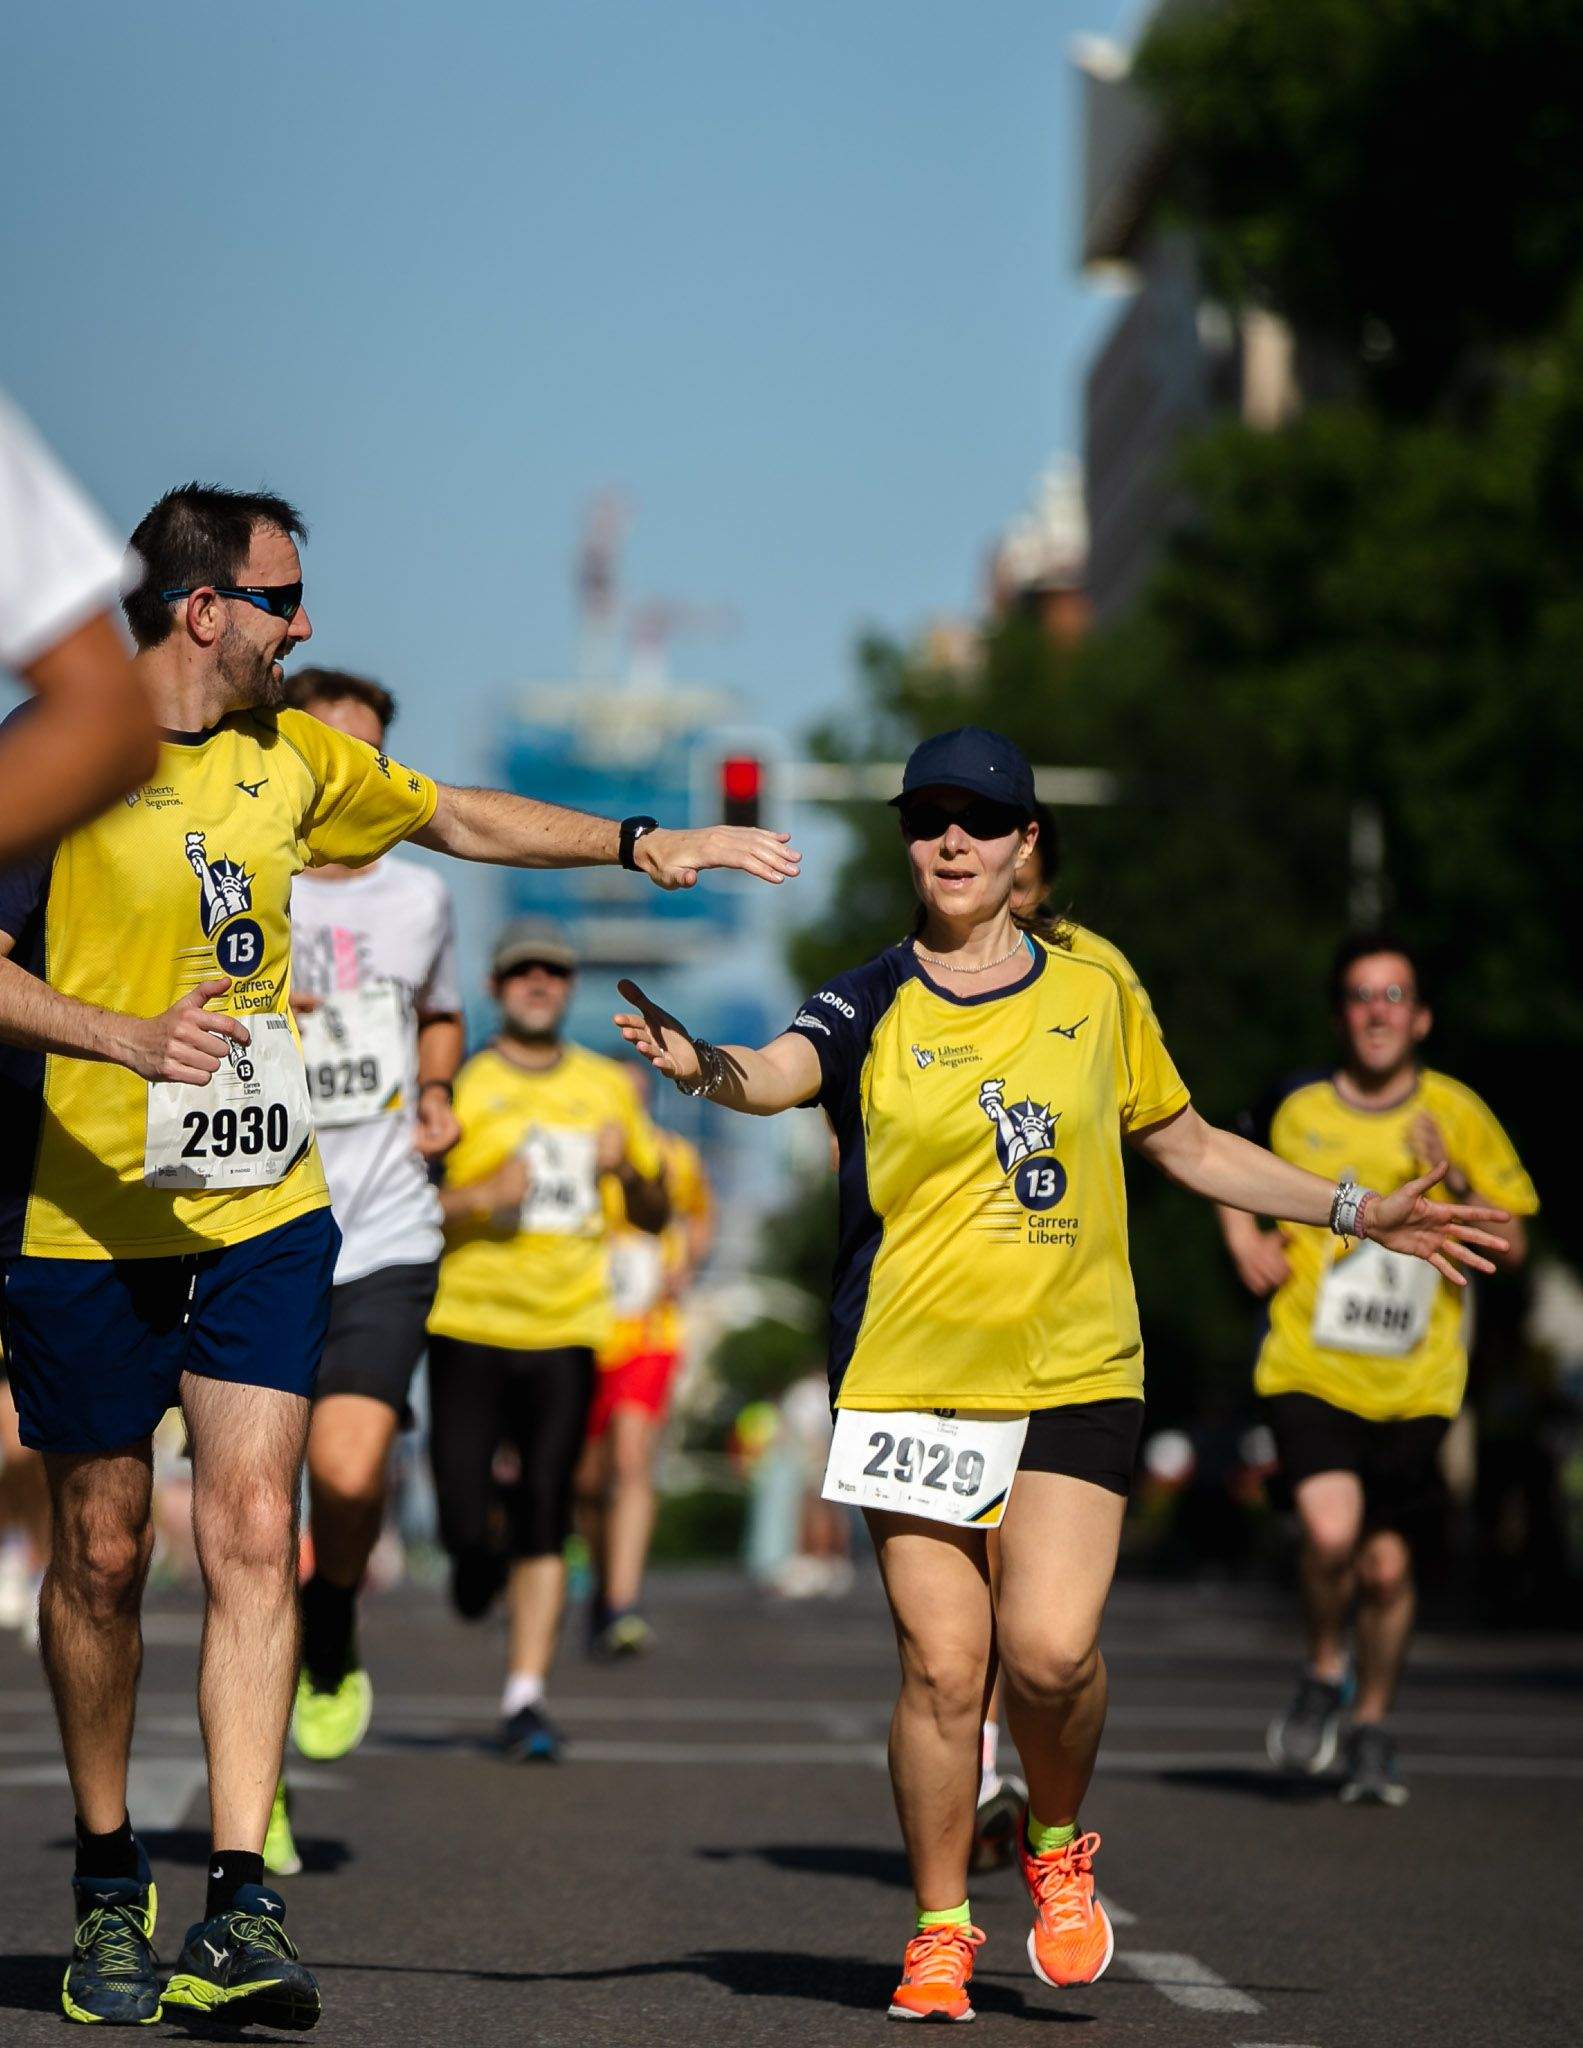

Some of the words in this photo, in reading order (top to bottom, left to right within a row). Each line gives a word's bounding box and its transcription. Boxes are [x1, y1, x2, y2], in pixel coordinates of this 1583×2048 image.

[142, 785, 175, 796] Liberty
[146, 798, 184, 810] Seguros.
[227, 932, 255, 963] 13
[234, 979, 275, 994] Carrera
[234, 994, 273, 1010] Liberty
[813, 991, 855, 1019] ADRID
[938, 1044, 974, 1056] Liberty
[940, 1055, 983, 1068] Seguros.
[239, 1064, 251, 1078] 13
[305, 1056, 379, 1099] 929
[181, 1103, 289, 1158] 2930
[1026, 1168, 1055, 1198] 13
[1028, 1214, 1079, 1229] Carrera
[1028, 1230, 1078, 1247] Liberty
[863, 1431, 986, 1497] 2929
